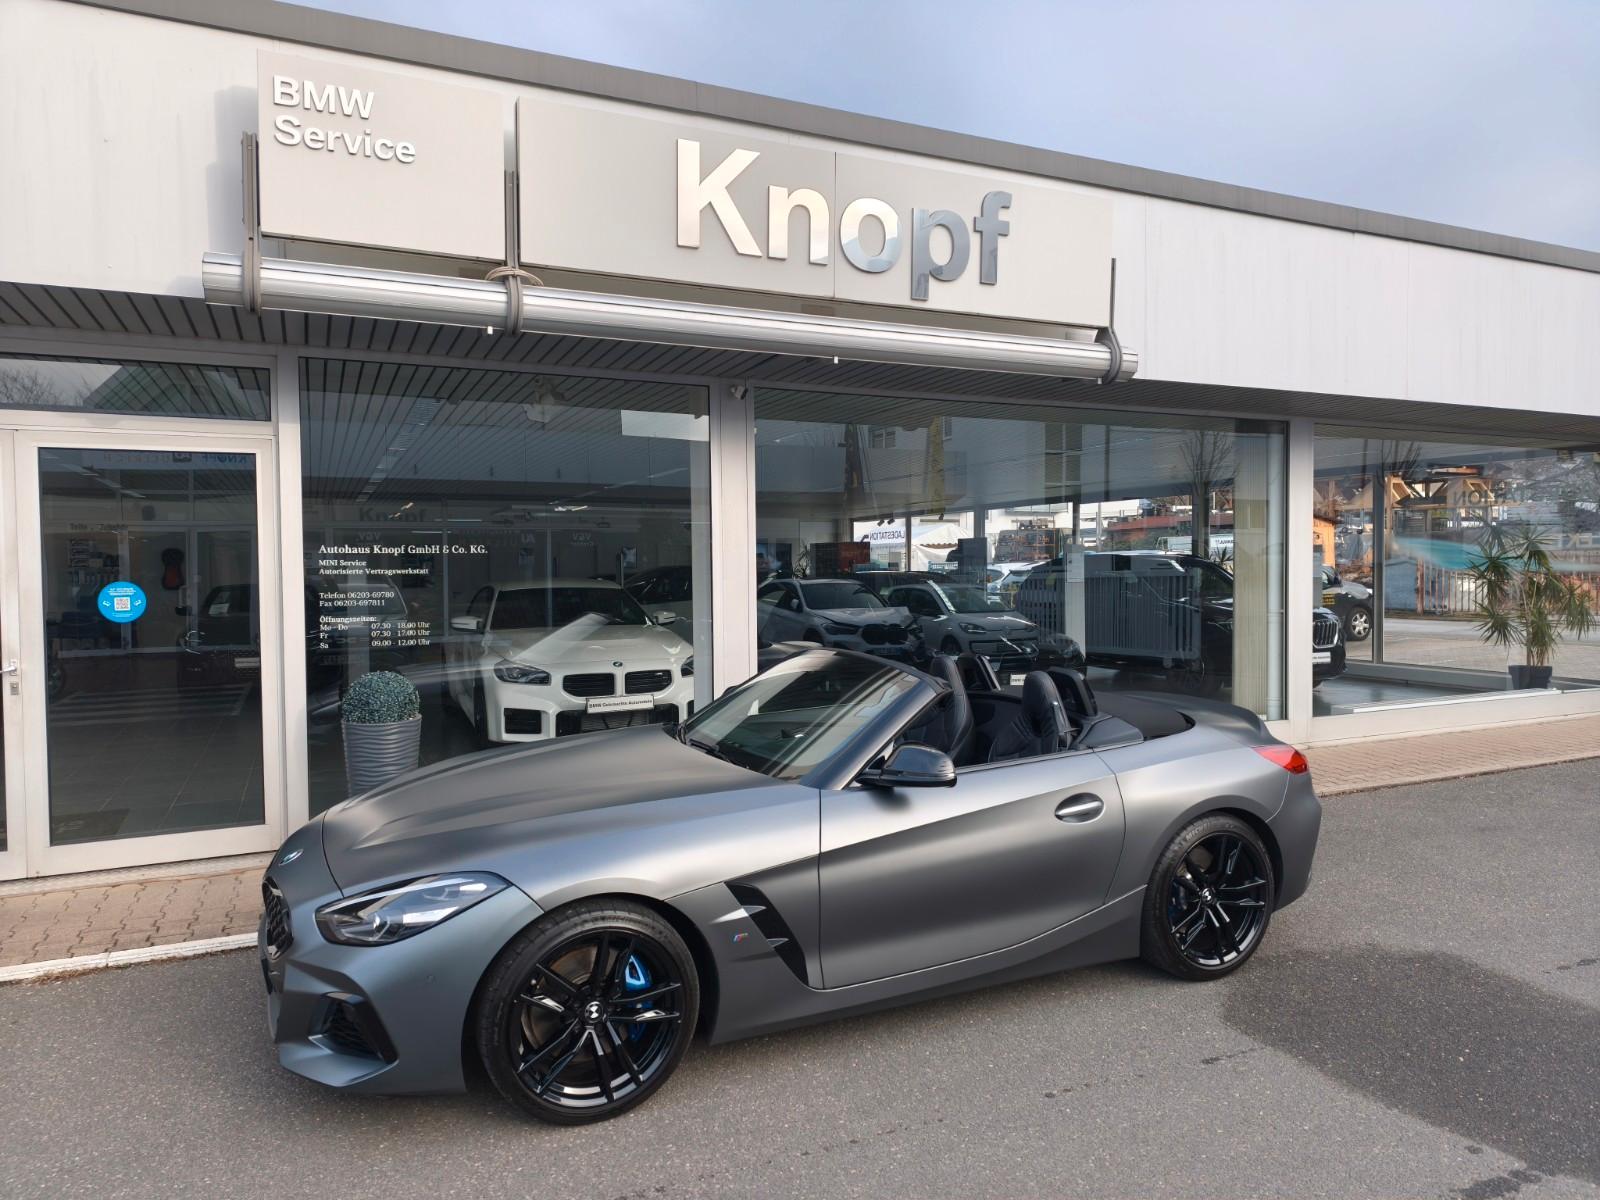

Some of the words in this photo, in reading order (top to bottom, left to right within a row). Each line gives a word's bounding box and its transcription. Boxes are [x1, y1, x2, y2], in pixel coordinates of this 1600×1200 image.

[273, 75, 375, 119] BMW
[274, 115, 416, 163] Service
[676, 138, 1013, 301] Knopf
[318, 544, 371, 554] Autohaus
[373, 544, 405, 556] Knopf
[408, 544, 440, 554] GmbH
[443, 545, 450, 554] &
[452, 545, 467, 554] Co.
[470, 545, 488, 554] KG.
[365, 567, 429, 576] Vertragswerkstatt
[347, 591, 395, 599] 06203-69780
[334, 599, 385, 607] 06203-697811
[338, 623, 349, 631] Do
[371, 622, 391, 630] 07.30
